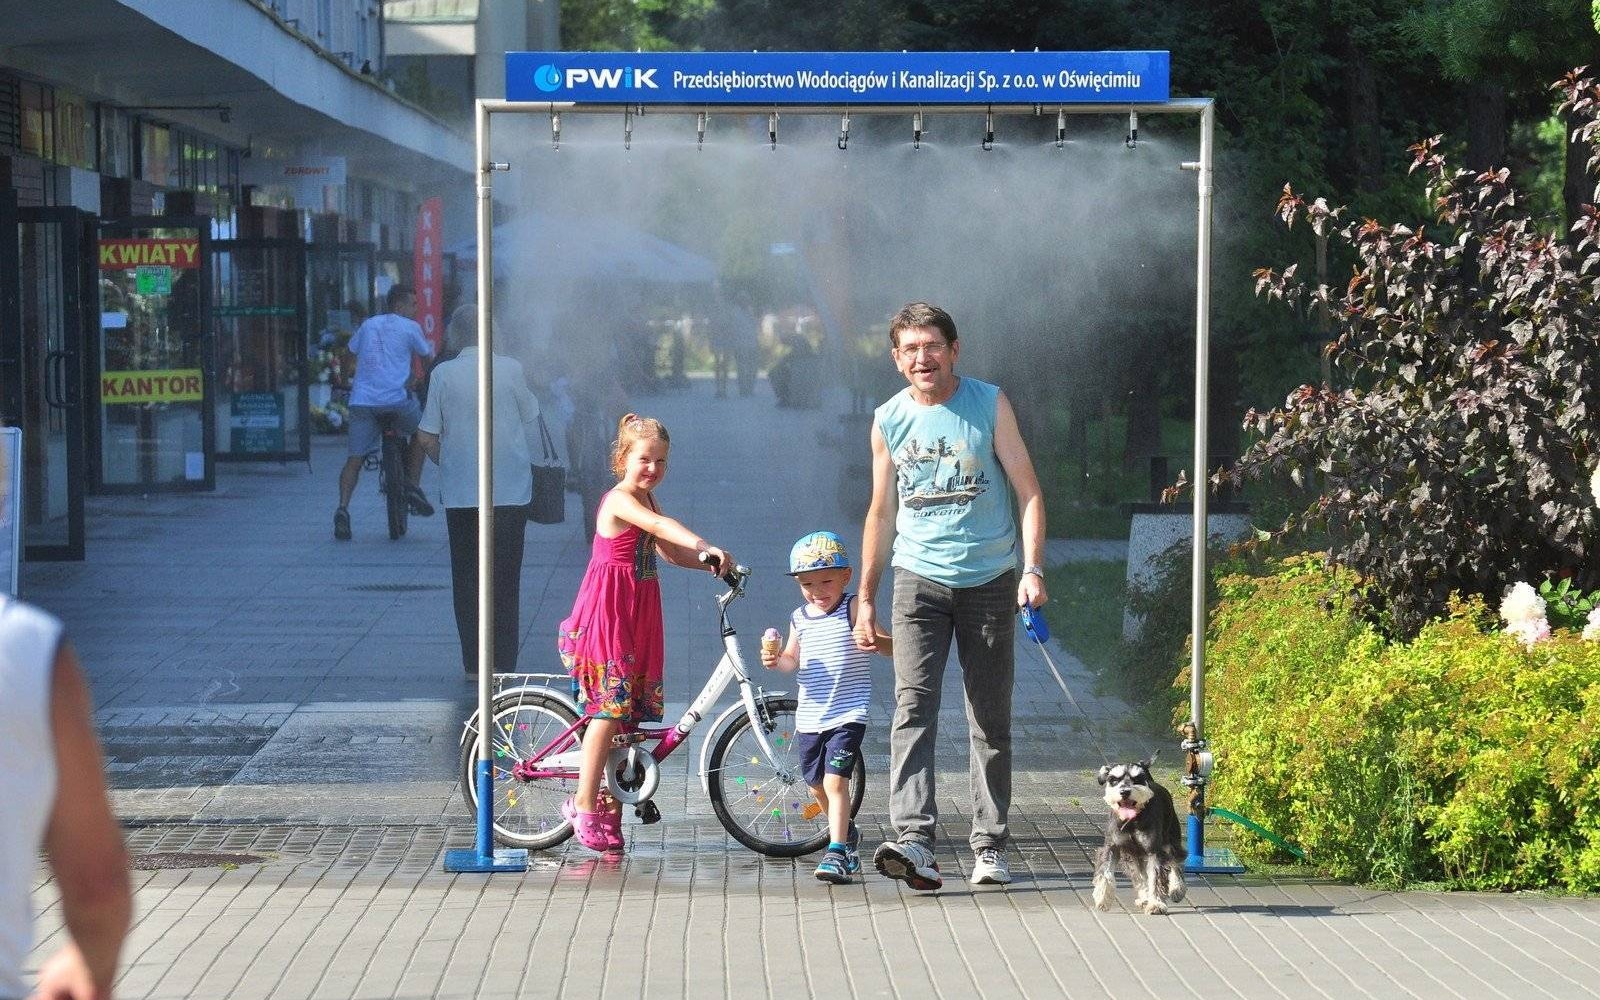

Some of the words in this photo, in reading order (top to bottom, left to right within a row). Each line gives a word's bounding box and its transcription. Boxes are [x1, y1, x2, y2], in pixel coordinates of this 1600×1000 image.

[566, 67, 659, 89] PWiK
[673, 70, 794, 92] Przedsiębiorstwo
[797, 70, 888, 92] Wodociągów
[892, 71, 896, 88] i
[900, 70, 974, 92] Kanalizacji
[978, 70, 999, 92] Sp.
[1003, 74, 1010, 88] z
[1014, 74, 1038, 89] o.o.
[1042, 74, 1055, 88] w
[1058, 70, 1140, 92] Oświęcimiu
[100, 243, 198, 264] KWIATY
[102, 376, 201, 396] KANTOR
